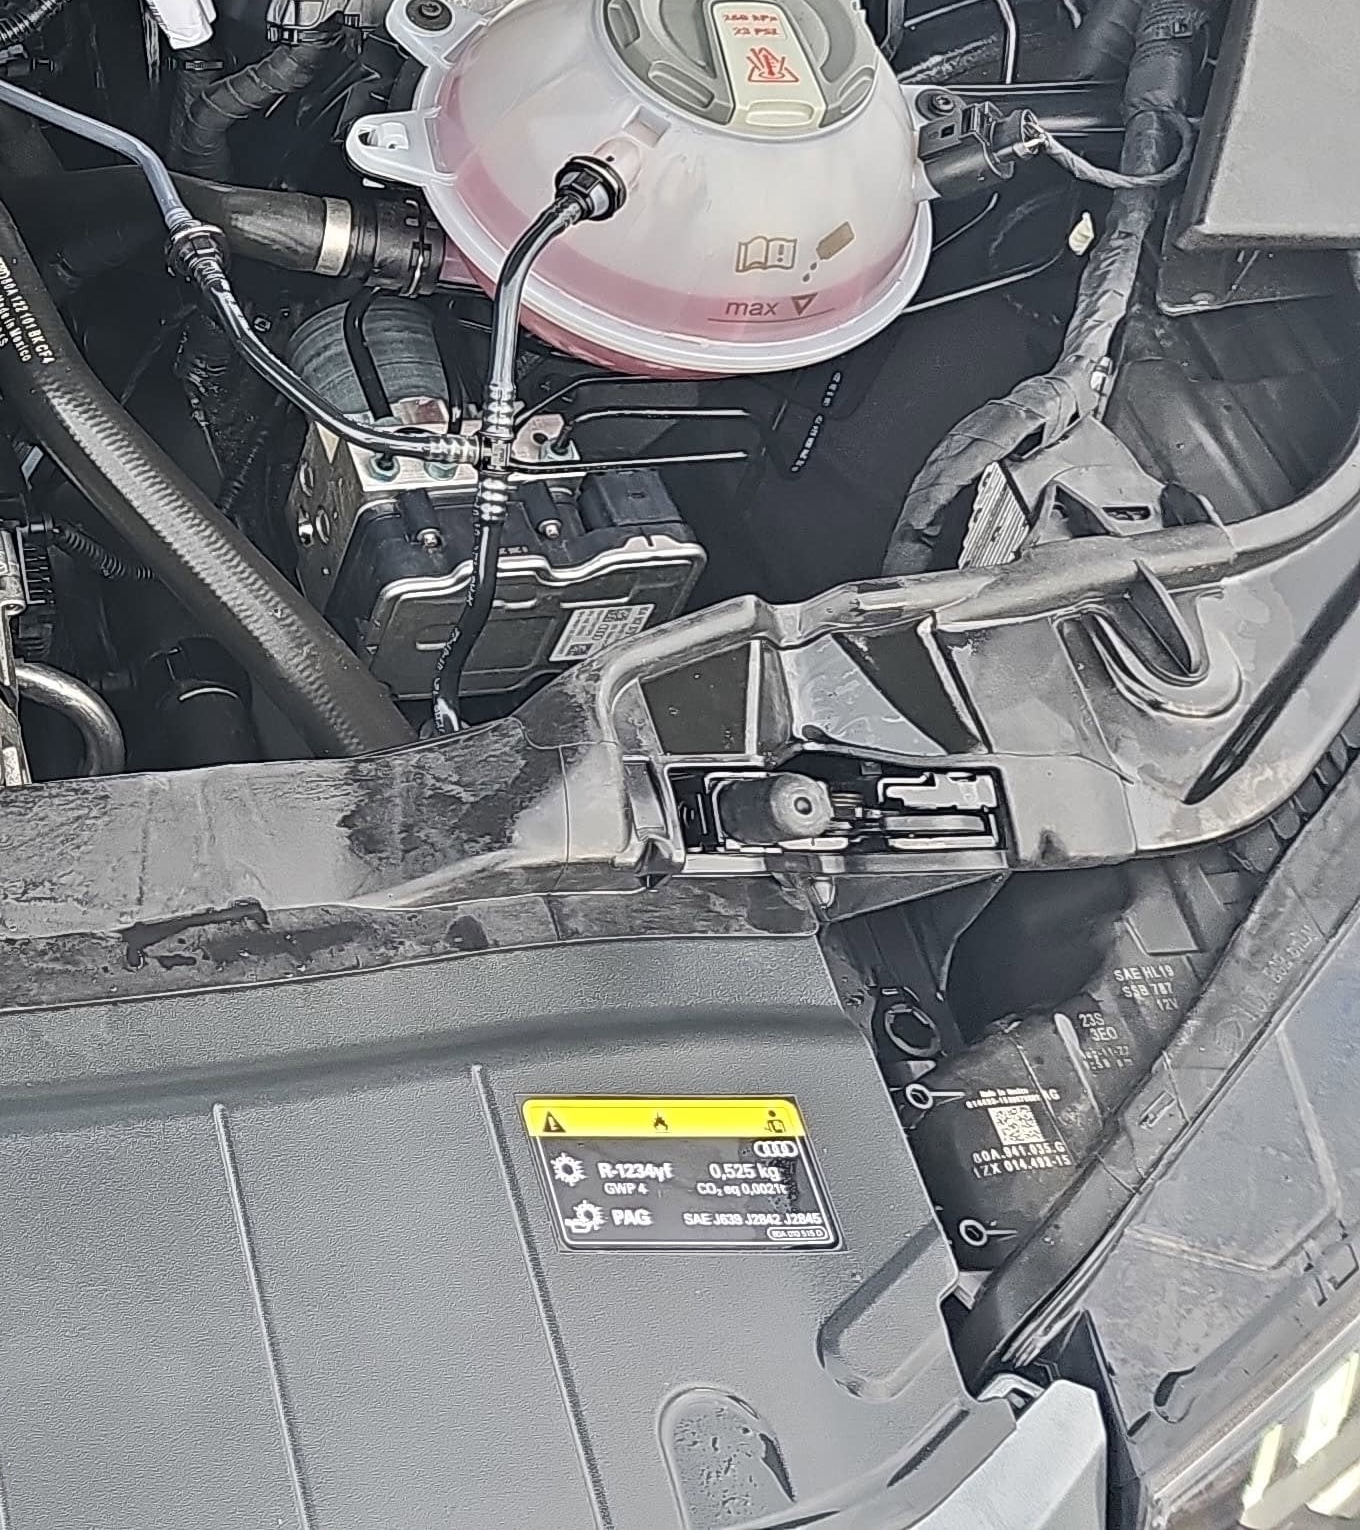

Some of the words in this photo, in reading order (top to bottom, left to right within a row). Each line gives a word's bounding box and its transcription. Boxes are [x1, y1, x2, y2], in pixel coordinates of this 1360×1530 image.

[725, 301, 780, 316] max
[1113, 967, 1143, 981] SAE
[1078, 1012, 1105, 1027] 23S
[597, 1162, 675, 1182] R-1234yf
[709, 1163, 757, 1180] 0,525
[757, 1163, 781, 1181] kg
[604, 1182, 636, 1195] GWP
[638, 1183, 649, 1195] 4
[724, 1185, 741, 1197] eq
[611, 1209, 654, 1226] PAG
[683, 1213, 714, 1226] SAE
